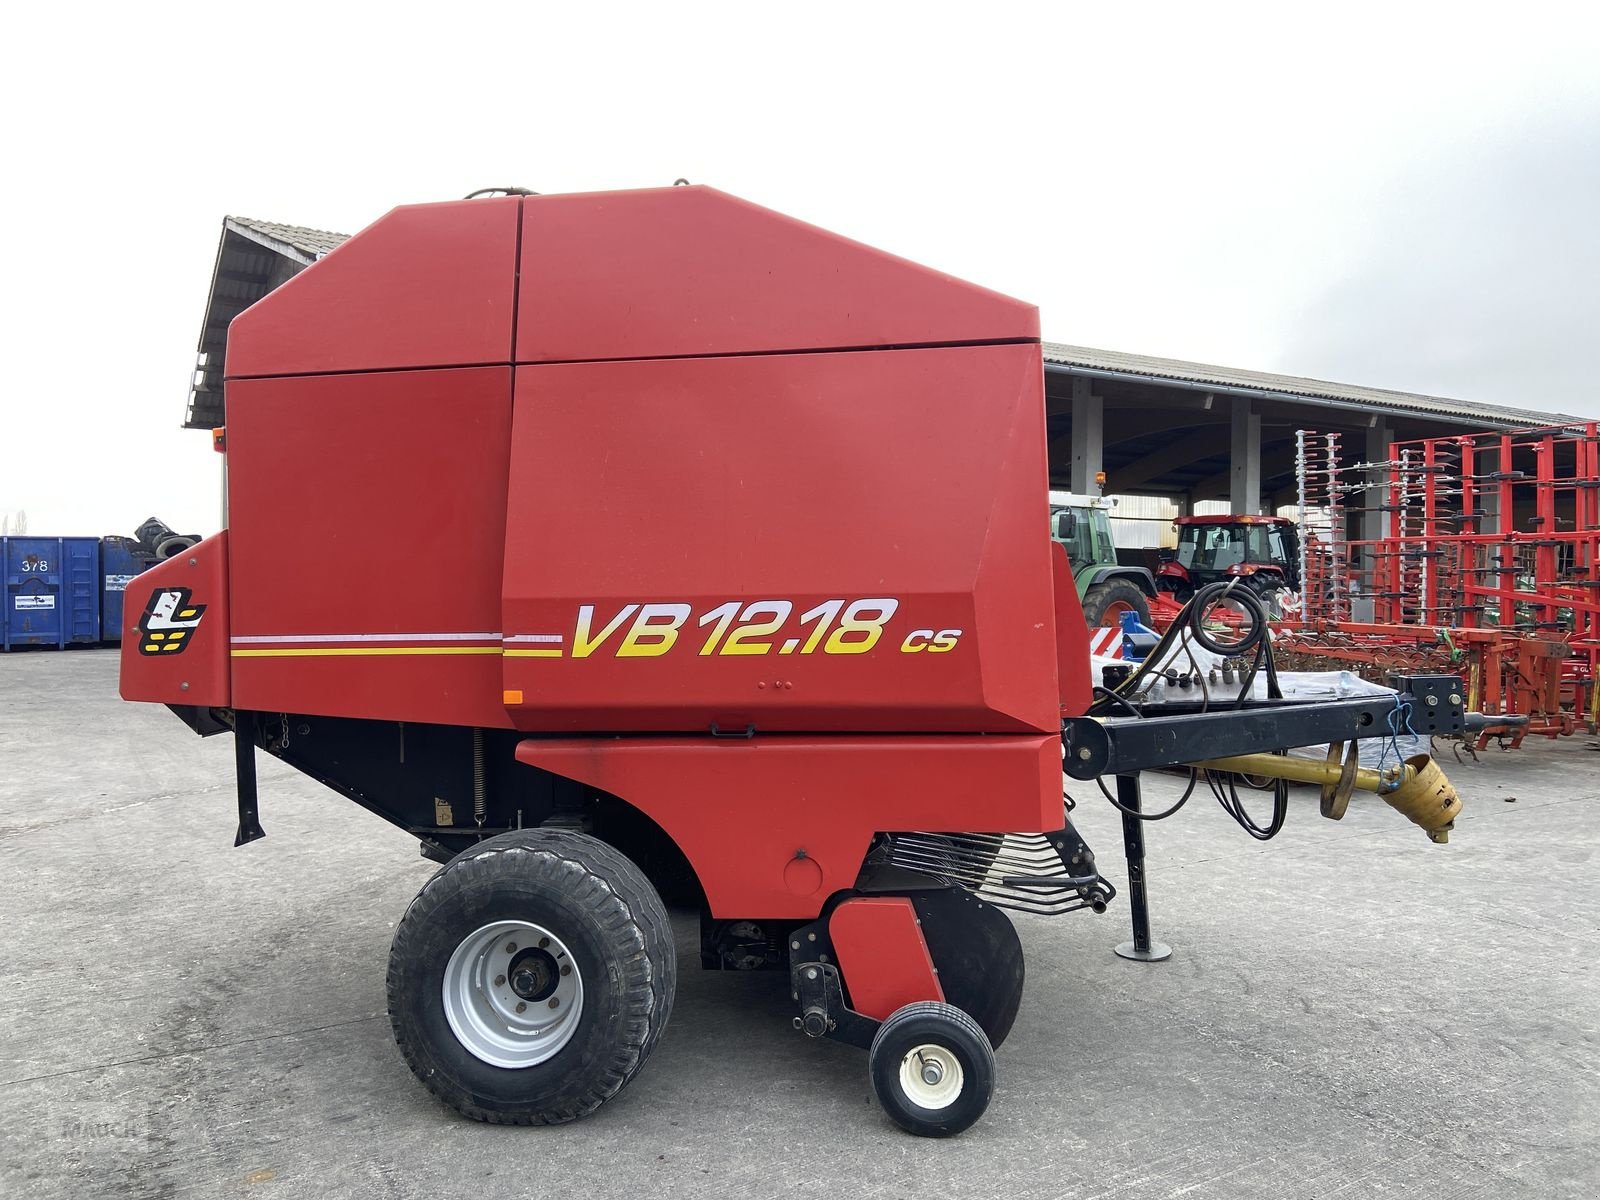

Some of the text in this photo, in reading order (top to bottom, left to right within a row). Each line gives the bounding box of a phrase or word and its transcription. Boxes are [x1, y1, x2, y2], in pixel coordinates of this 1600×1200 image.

[21, 561, 48, 573] 378
[571, 603, 692, 658] VB
[698, 598, 898, 656] 12.18
